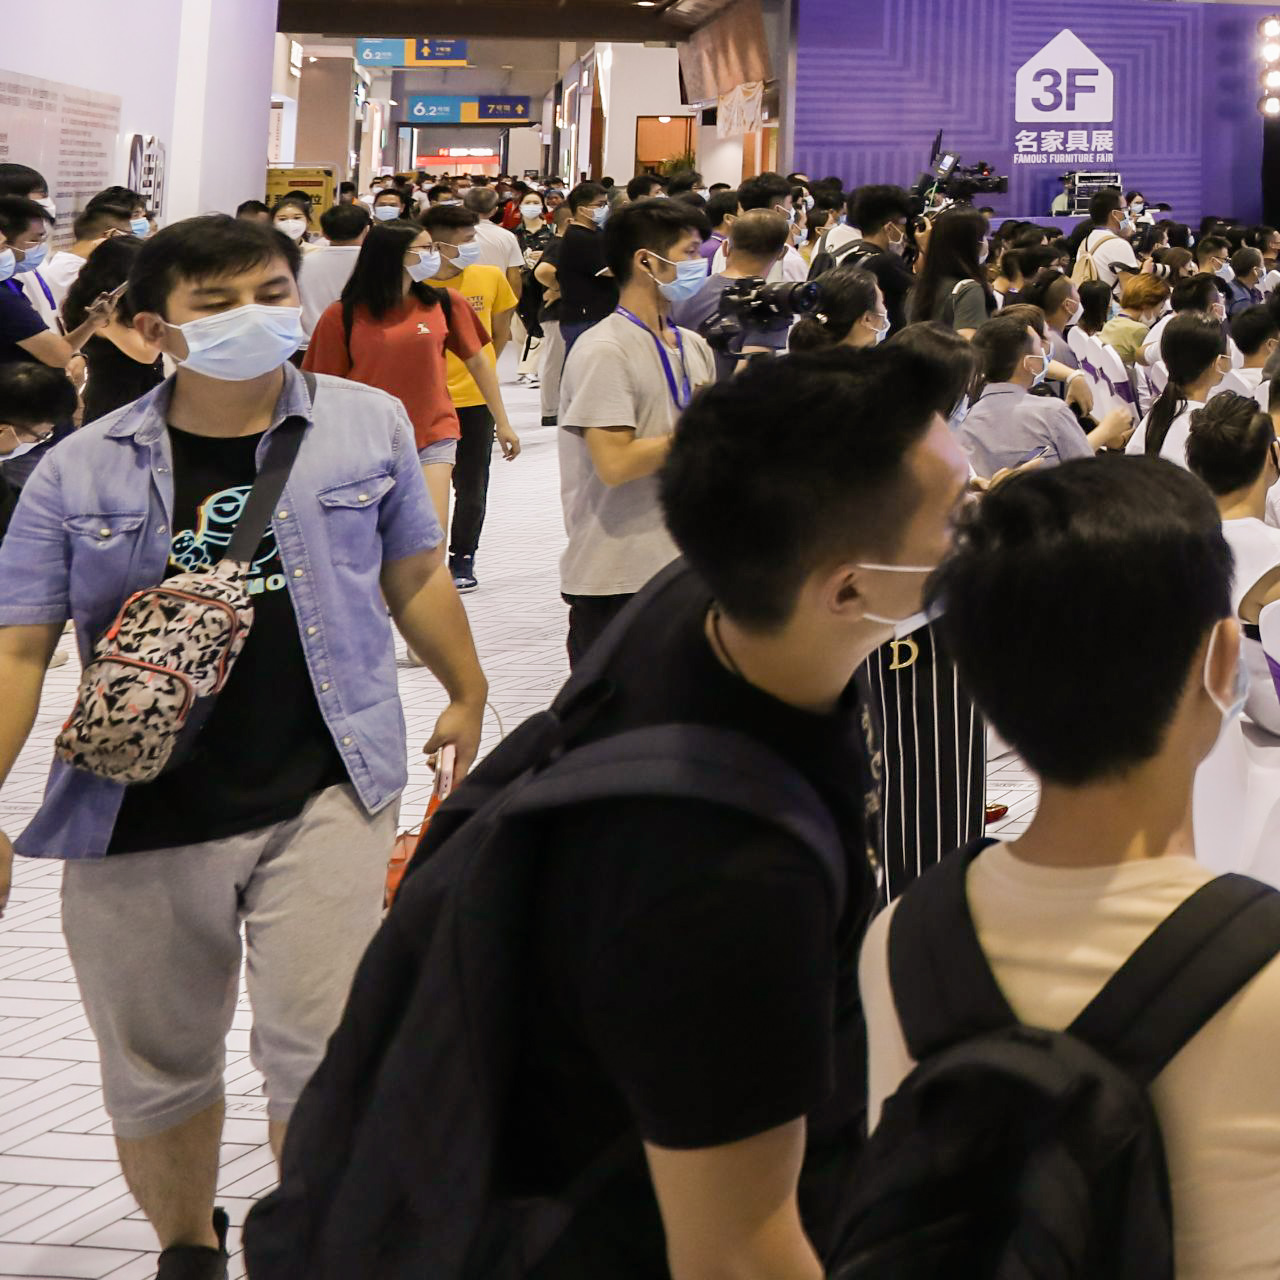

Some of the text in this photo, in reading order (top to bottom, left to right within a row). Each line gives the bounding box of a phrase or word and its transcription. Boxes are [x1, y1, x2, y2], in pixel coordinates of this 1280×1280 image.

[1031, 68, 1100, 112] 3F
[1014, 130, 1114, 152] 名家具展
[1013, 153, 1113, 164] FAMOUS FURNITURE FAIR
